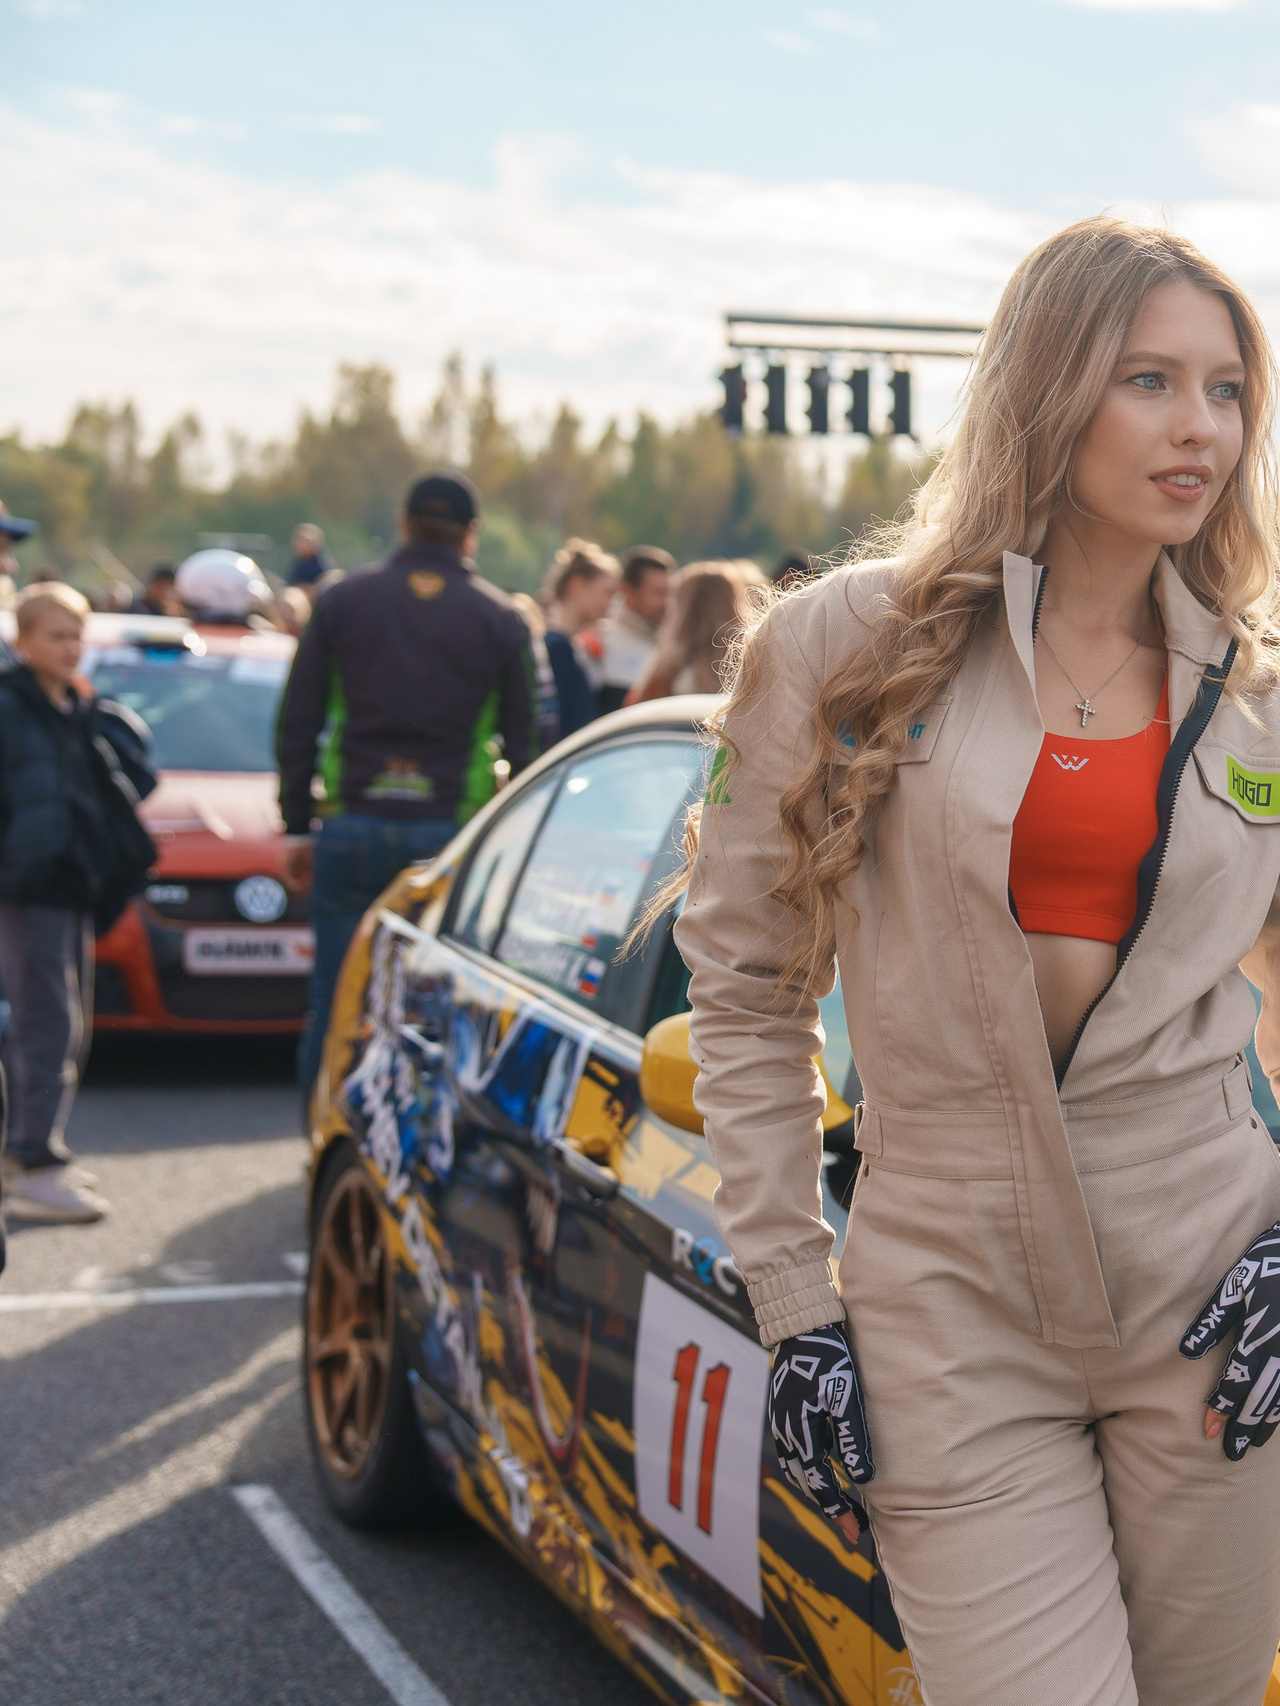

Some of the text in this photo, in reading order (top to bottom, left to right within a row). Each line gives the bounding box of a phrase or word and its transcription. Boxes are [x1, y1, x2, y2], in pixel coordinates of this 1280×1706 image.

[1231, 766, 1272, 807] HOGO
[1184, 1303, 1226, 1351] ЖГИ
[668, 1340, 731, 1537] 11
